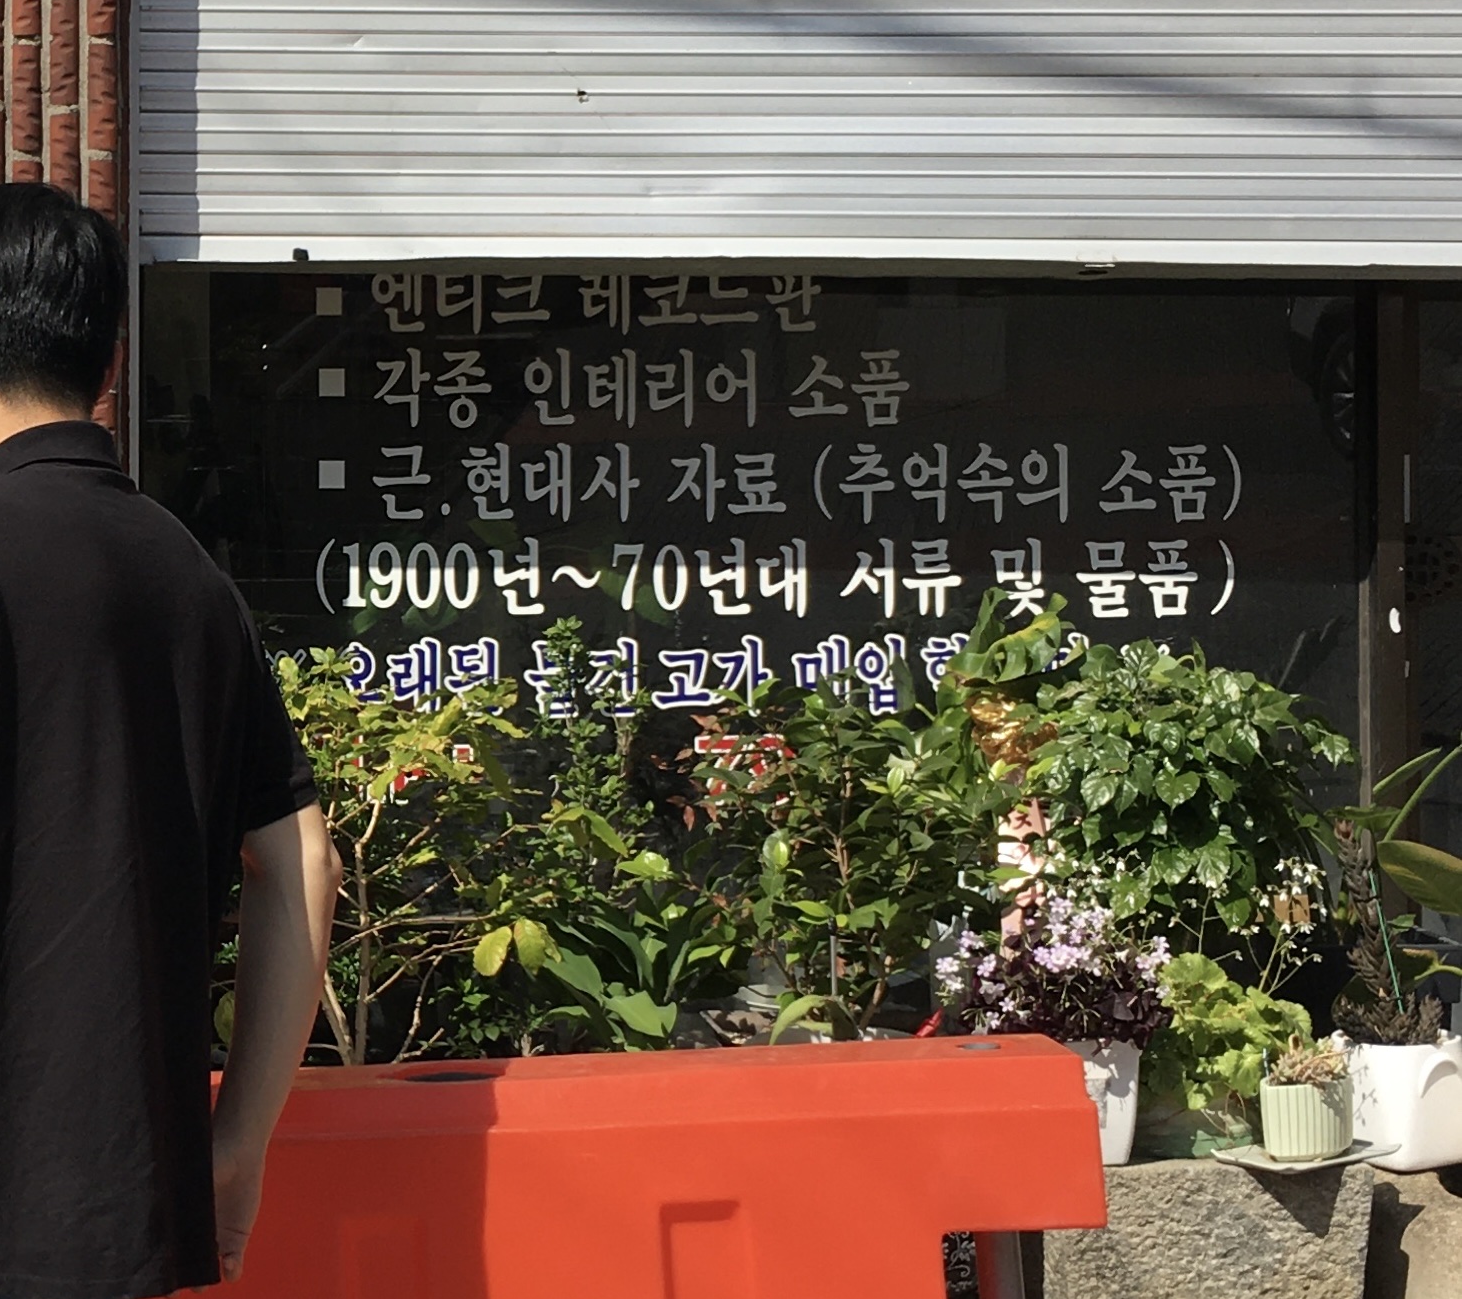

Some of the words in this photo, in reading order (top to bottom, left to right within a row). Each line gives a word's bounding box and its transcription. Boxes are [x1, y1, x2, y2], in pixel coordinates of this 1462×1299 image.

[373, 347, 493, 428] 각종
[523, 347, 757, 429] 인테리어
[788, 349, 911, 428] 소품
[1098, 443, 1242, 523] 소품)
[839, 537, 962, 618] 서류
[990, 537, 1045, 618] 및
[650, 634, 774, 718] 고가
